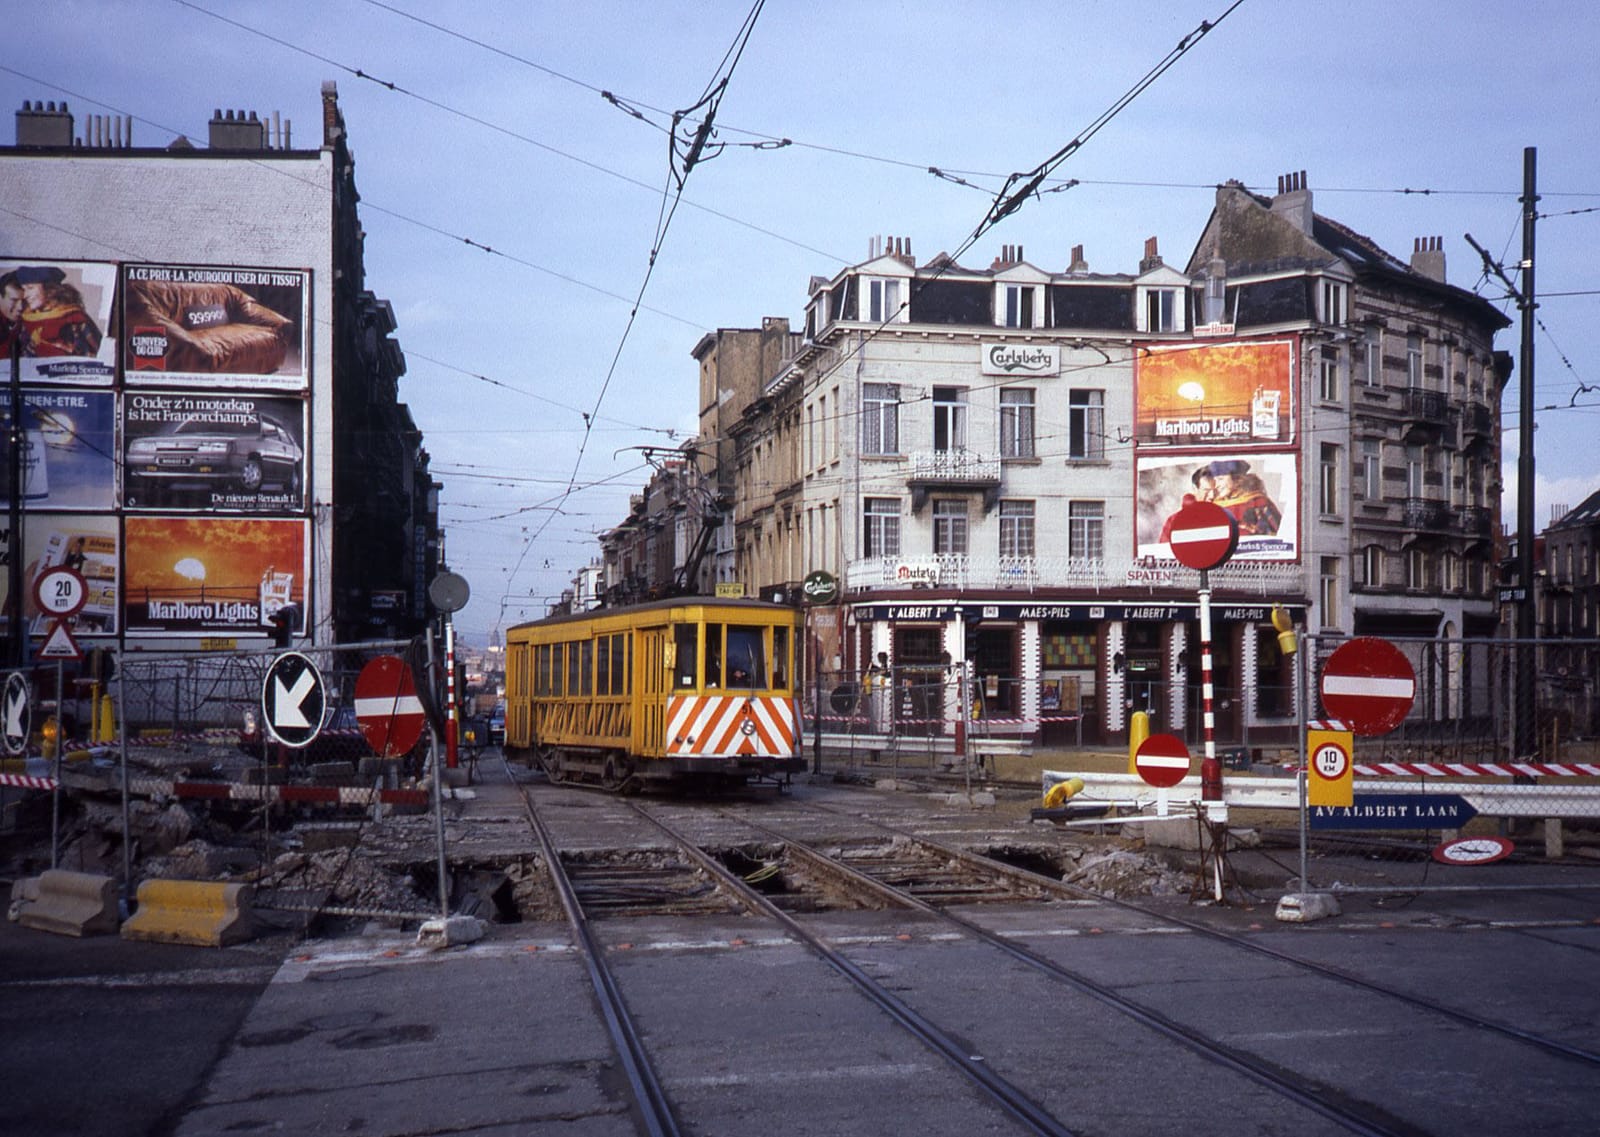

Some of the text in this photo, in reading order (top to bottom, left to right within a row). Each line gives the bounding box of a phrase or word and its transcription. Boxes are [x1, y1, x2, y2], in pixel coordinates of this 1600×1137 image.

[129, 269, 136, 280] A
[137, 269, 148, 280] CE
[188, 271, 232, 283] POURQUOI
[234, 272, 256, 284] USER
[258, 274, 270, 285] DU
[271, 274, 301, 287] TISSU?
[989, 345, 1052, 372] Carlsberg
[133, 396, 255, 413] Onder z'n motorkap
[128, 409, 259, 427] is het Francorchamps.
[1156, 418, 1210, 436] Marlboro
[1212, 418, 1250, 437] Lights
[211, 493, 225, 502] De
[226, 493, 257, 503] nieuwe
[258, 493, 289, 503] Renault
[1127, 570, 1171, 581] SPATEN
[55, 580, 72, 597] 20
[148, 601, 259, 622] Marlboro Lights
[1324, 750, 1337, 764] 10
[1343, 806, 1408, 817] ALBERT
[1415, 805, 1459, 817] LAAN
